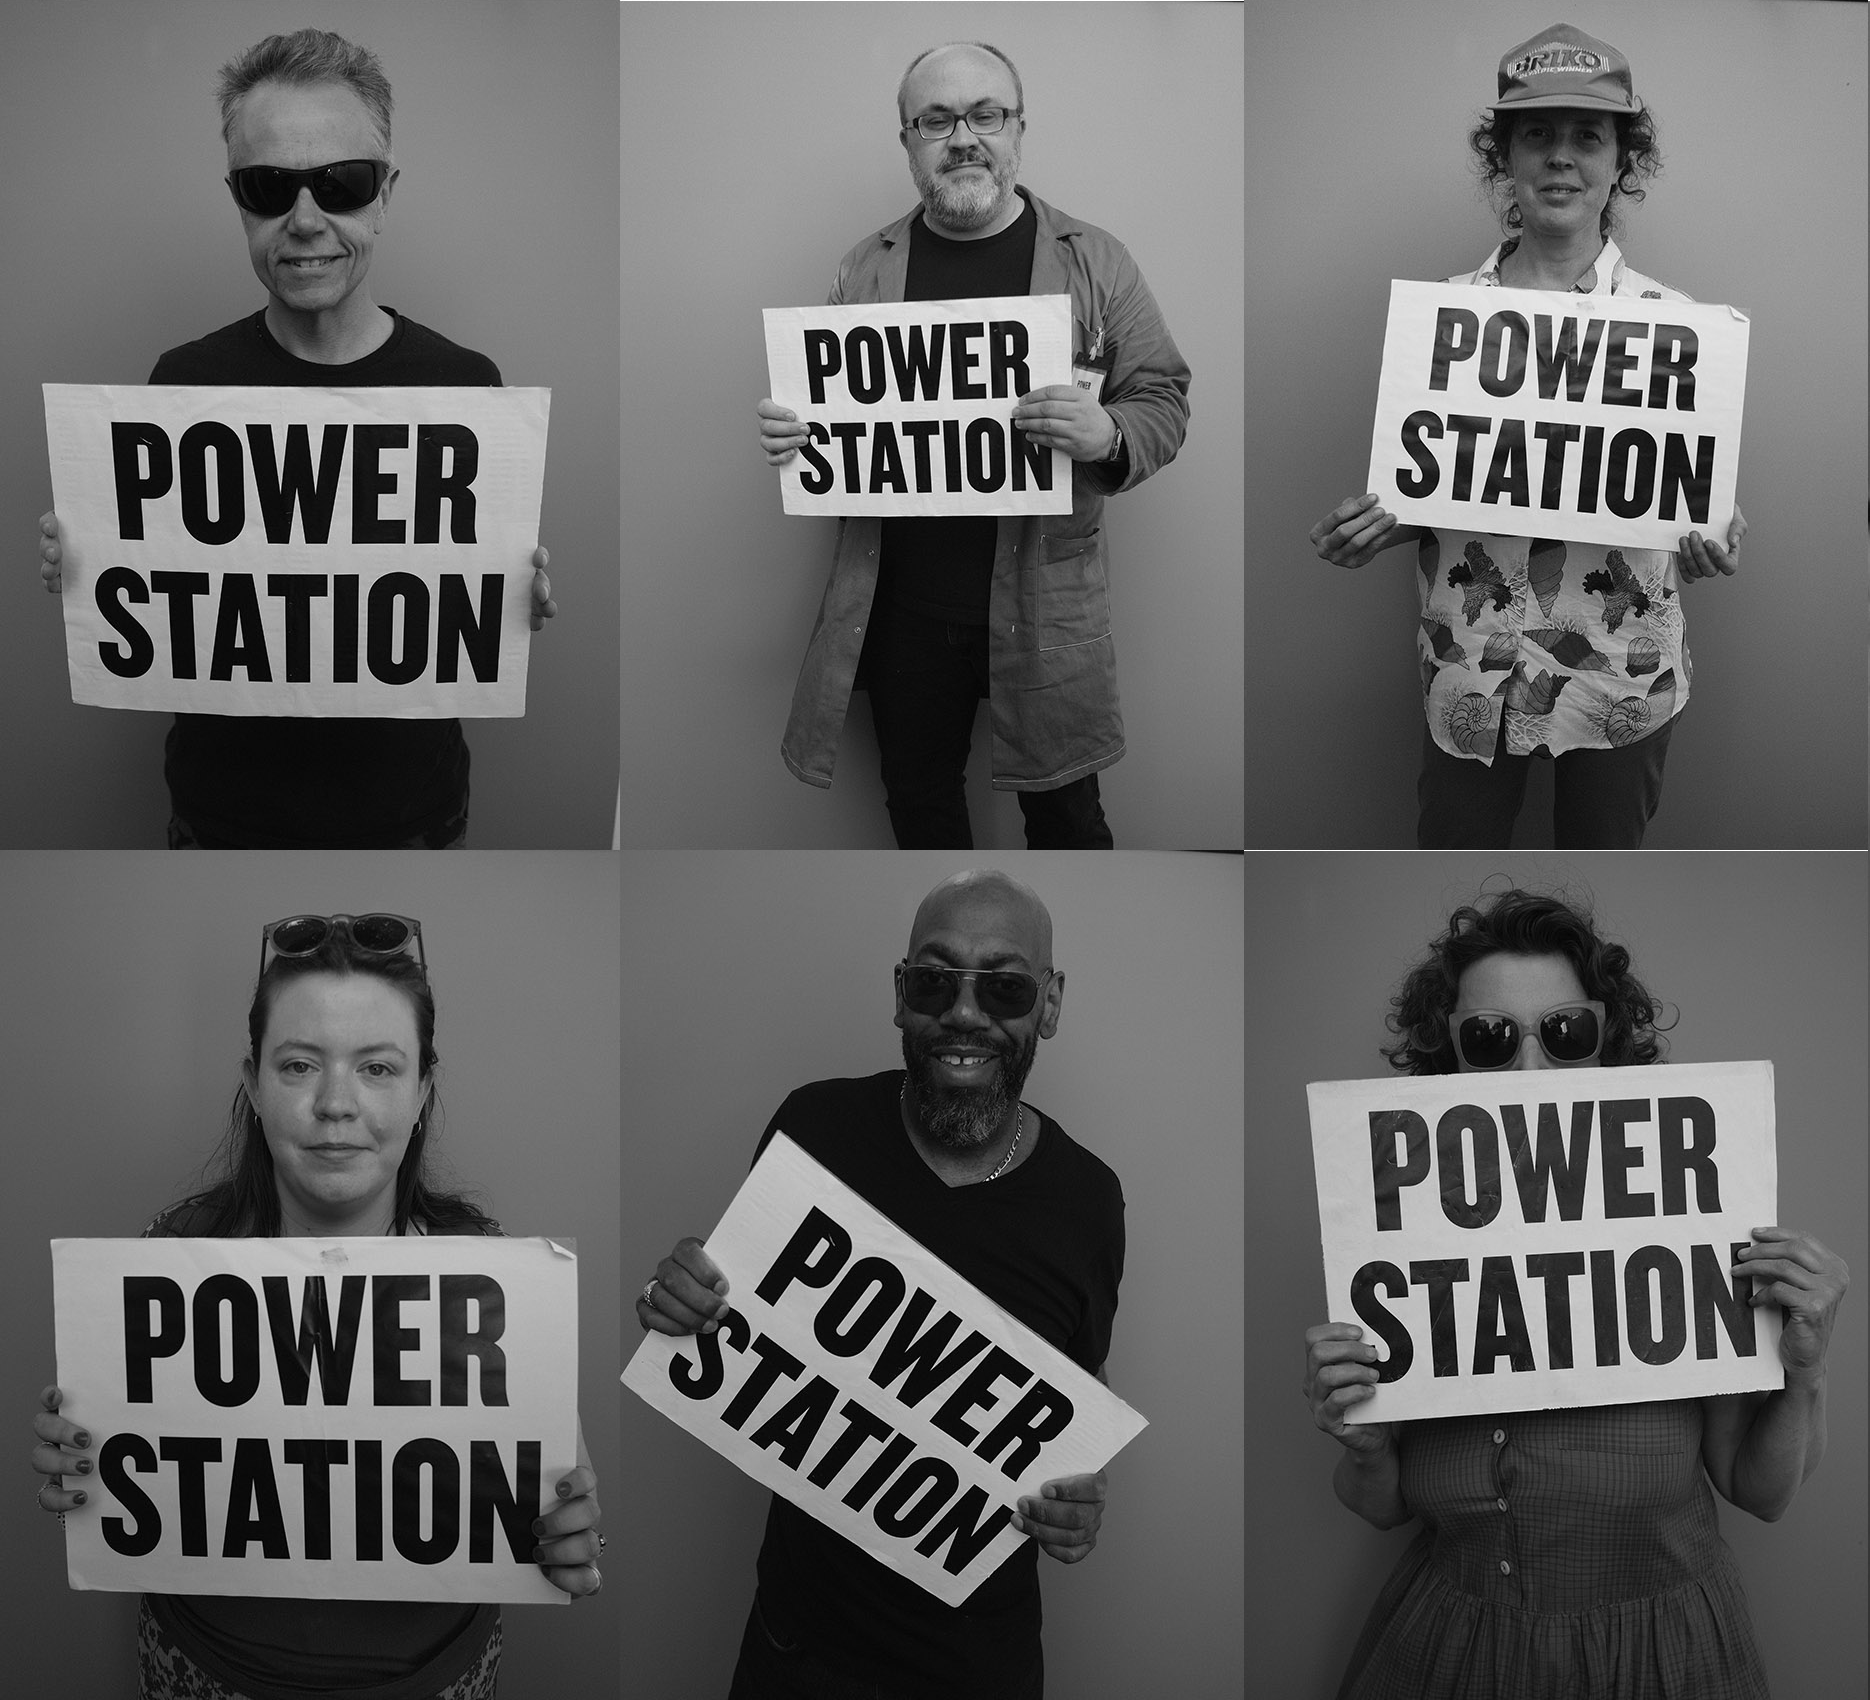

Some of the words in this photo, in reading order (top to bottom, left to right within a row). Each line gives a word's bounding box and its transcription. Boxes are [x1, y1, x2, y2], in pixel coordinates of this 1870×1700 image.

[1515, 50, 1601, 72] BRIKO
[804, 321, 1030, 404] POWER
[1076, 379, 1092, 391] POWER
[1429, 307, 1698, 412] POWER
[111, 421, 478, 545] POWER
[798, 418, 1054, 493] STATION
[1396, 410, 1715, 524] STATION
[95, 567, 504, 685] STATION
[1369, 1097, 1722, 1231] POWER
[123, 1274, 509, 1407] POWER
[749, 1205, 1075, 1490] POWER
[1349, 1241, 1758, 1384] STATION
[99, 1433, 542, 1565] STATION
[667, 1308, 1019, 1578] STATION
